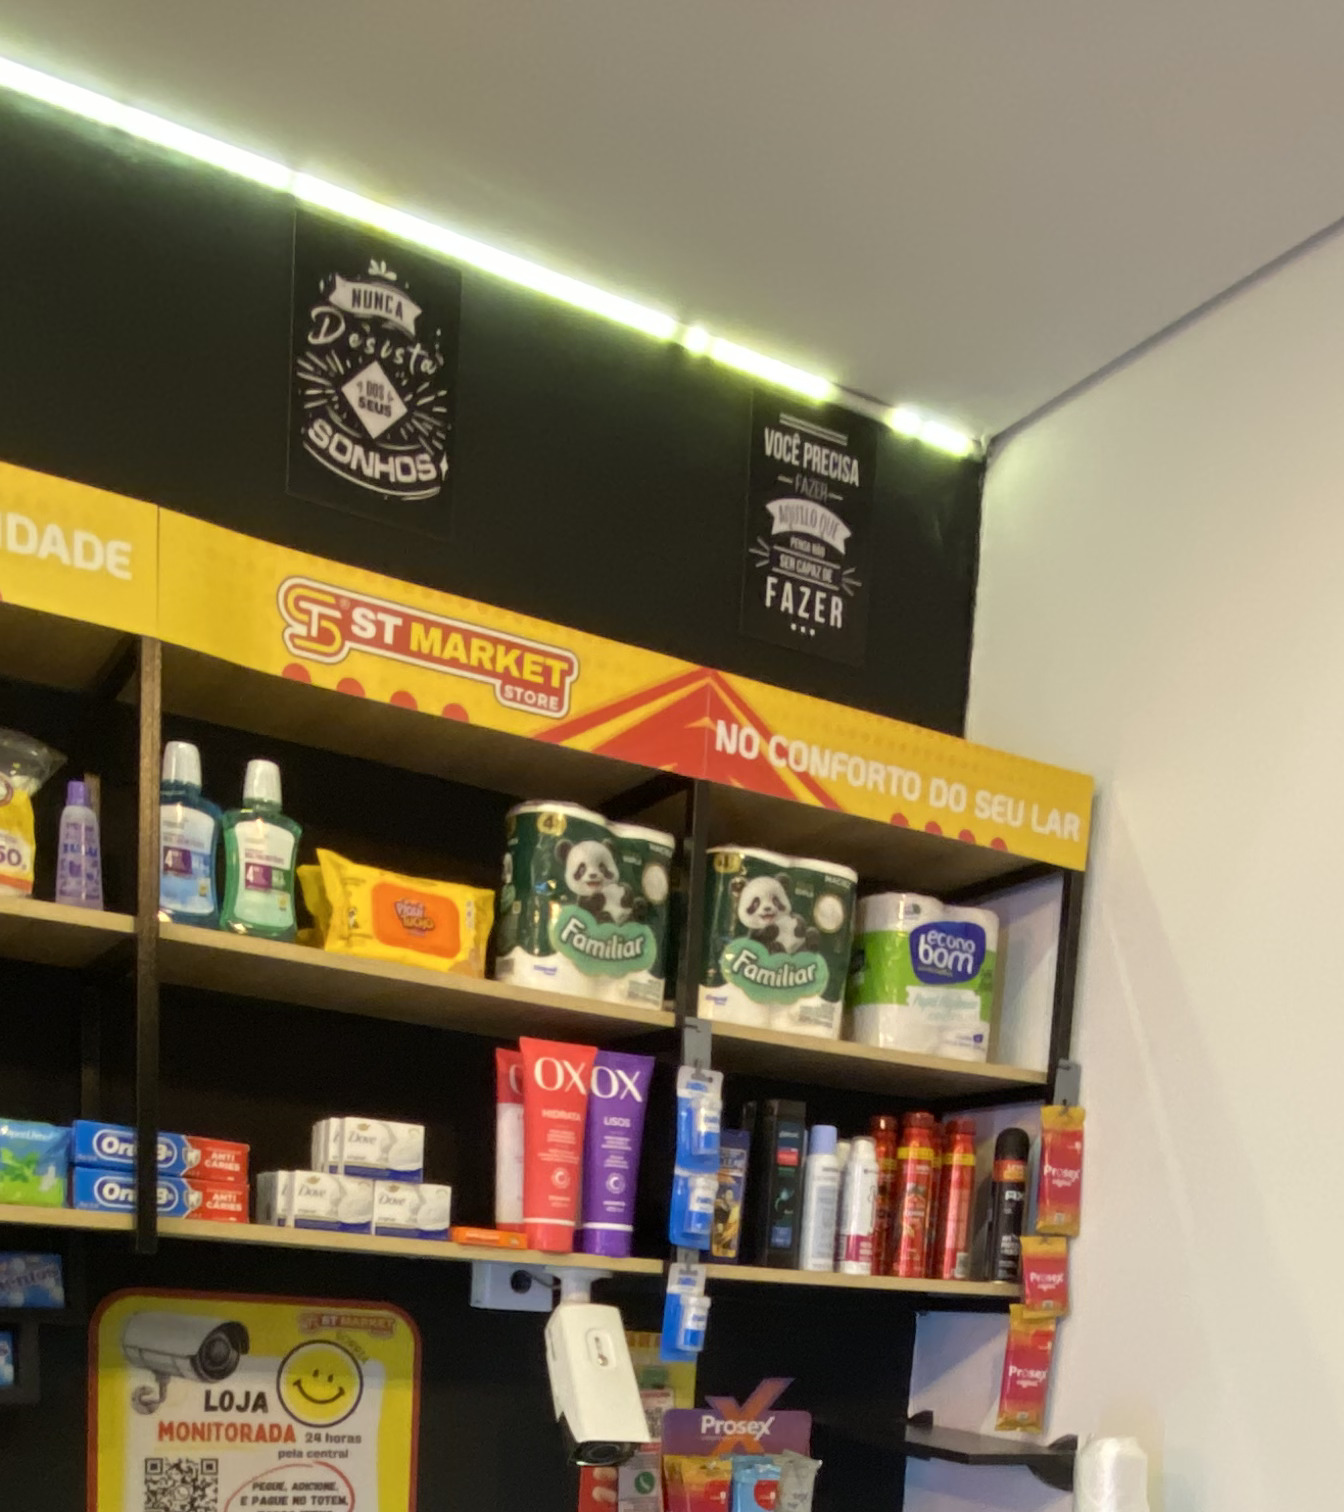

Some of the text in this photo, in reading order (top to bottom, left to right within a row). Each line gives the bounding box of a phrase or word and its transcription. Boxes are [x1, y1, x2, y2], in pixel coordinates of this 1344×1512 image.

[351, 287, 403, 322] NUNCA
[307, 305, 437, 376] Desista
[365, 380, 385, 397] DOS
[357, 396, 392, 418] SEUS
[307, 418, 437, 483] SONHOS
[764, 426, 860, 487] VOCÊ PRECISA
[794, 473, 829, 500] FAZER
[778, 504, 840, 541] AQUILO QUE
[796, 557, 822, 578] CAPAZ
[764, 575, 844, 630] FAZER
[350, 605, 570, 689] ST MARKET
[503, 683, 561, 710] STORE
[715, 718, 1081, 844] NO CONFORTO DO SEU LAR
[561, 916, 646, 961] Familiar
[926, 929, 977, 952] econo
[918, 934, 974, 975] bom
[731, 949, 818, 990] Familiar
[533, 1056, 588, 1097] OX
[590, 1065, 644, 1103] OX
[603, 1116, 632, 1128] LISOS
[346, 1128, 378, 1147] Dove
[1043, 1164, 1082, 1182] Prosex
[296, 1184, 328, 1201] Dove
[377, 1191, 408, 1208] Dove
[1008, 1365, 1048, 1384] Prosex
[204, 1389, 269, 1414] LOJA
[158, 1420, 363, 1445] MONITORADA 24 horas
[700, 1414, 776, 1441] Prosex
[278, 1447, 349, 1461] pela central
[240, 1495, 248, 1507] E
[251, 1495, 289, 1507] PAGUE
[292, 1495, 308, 1507] NO
